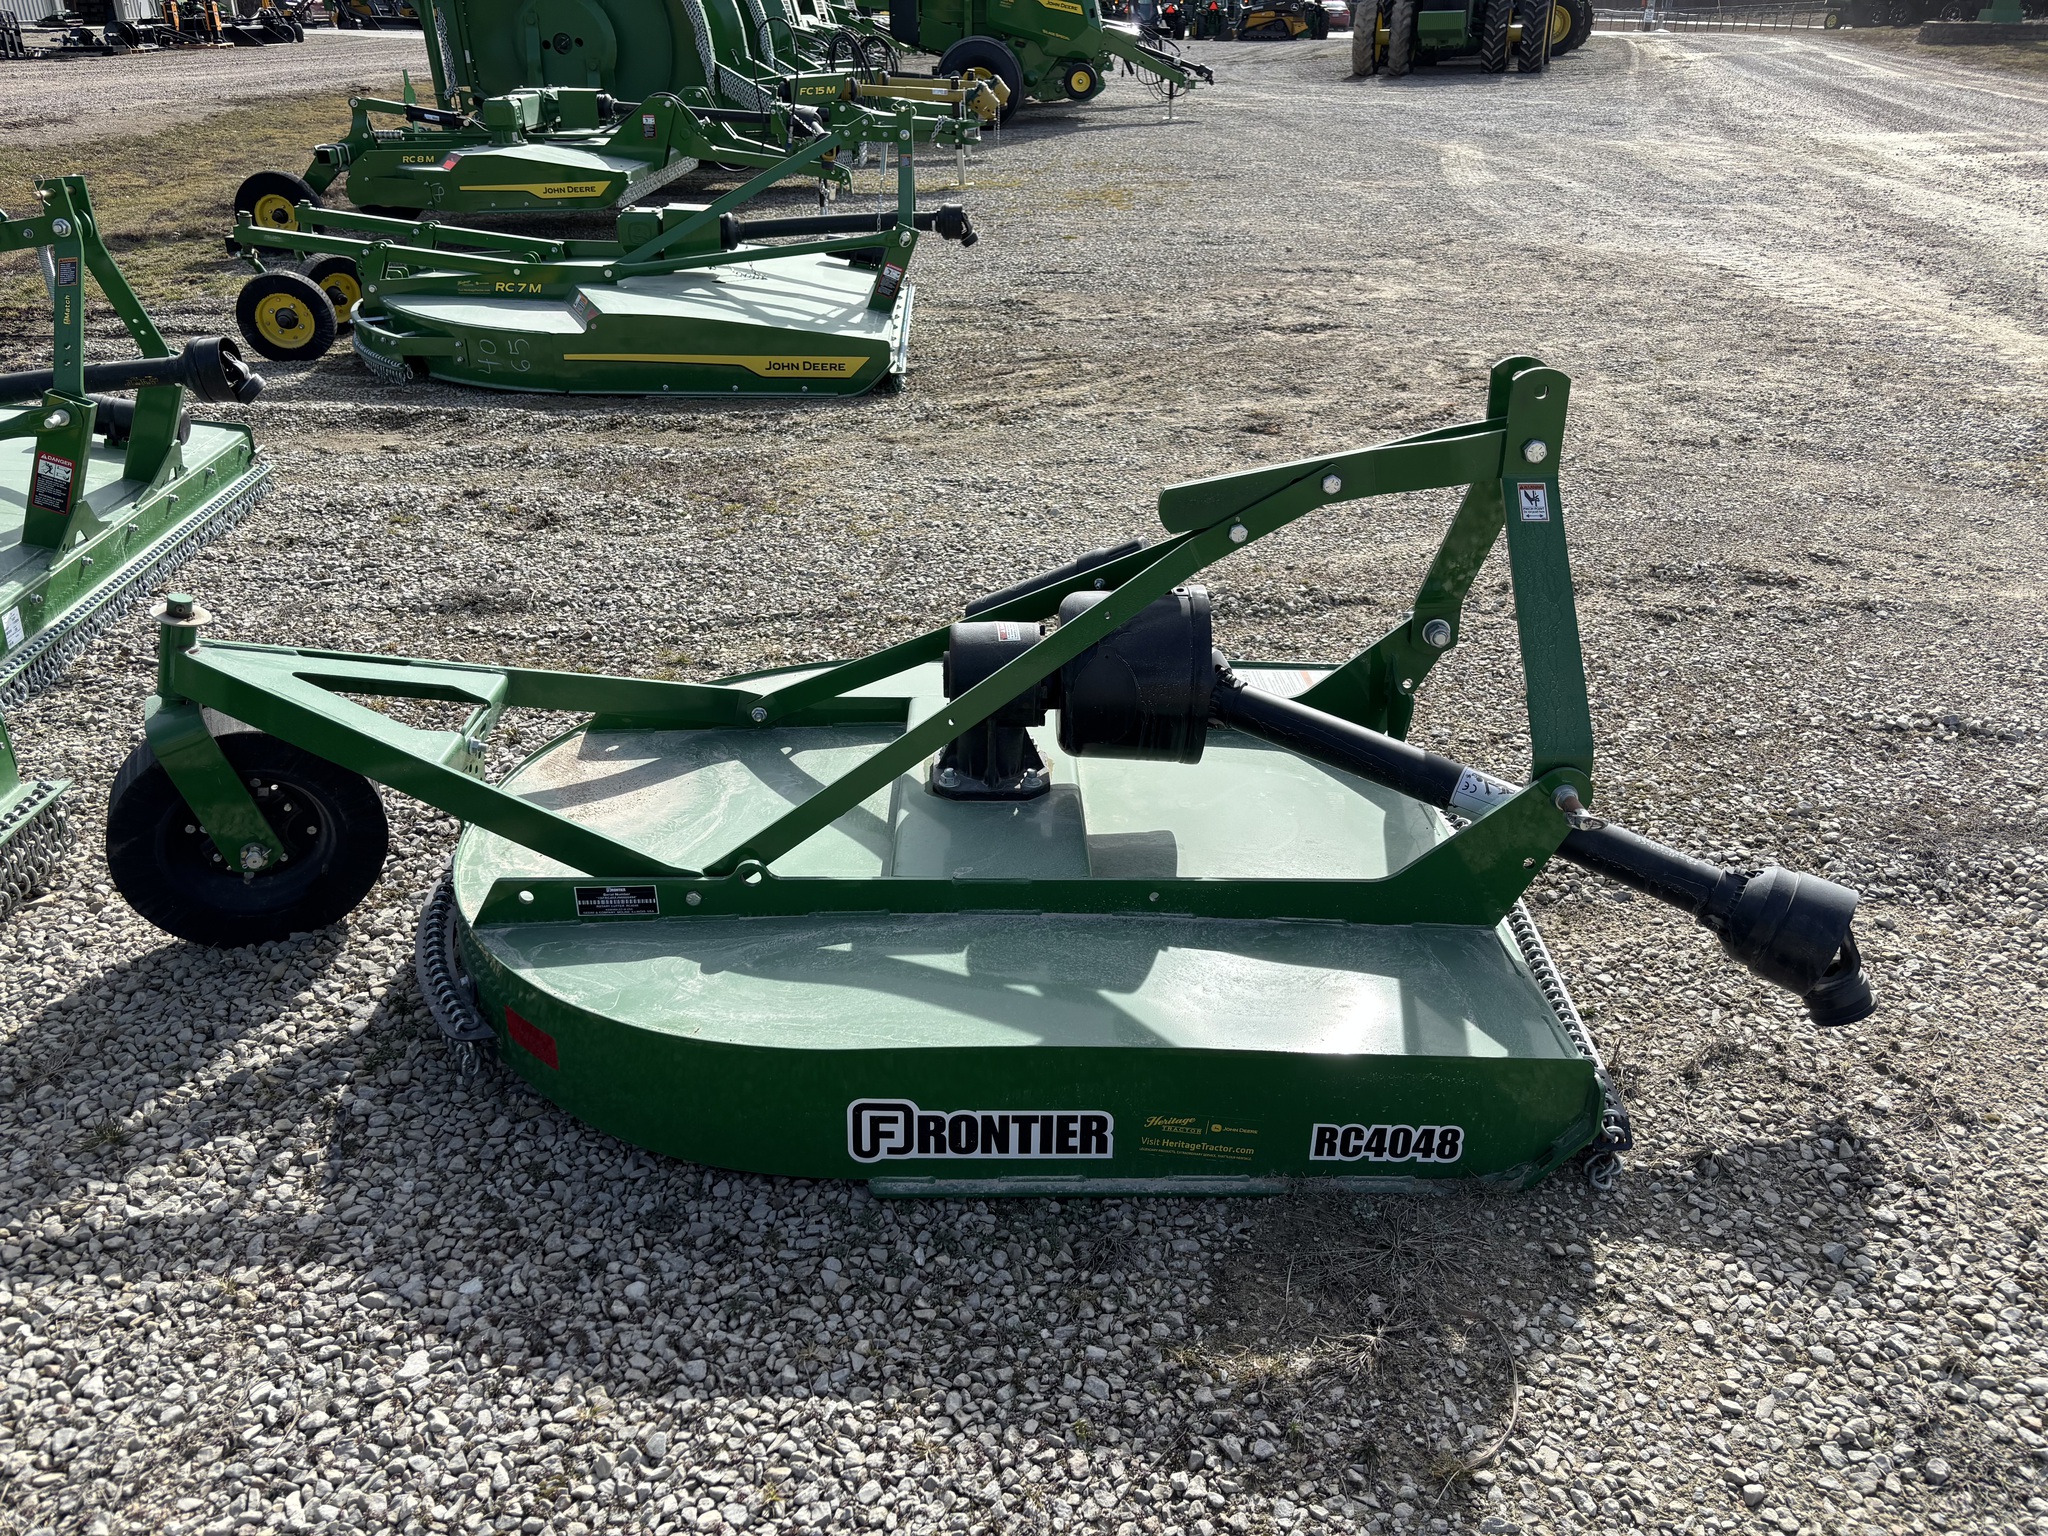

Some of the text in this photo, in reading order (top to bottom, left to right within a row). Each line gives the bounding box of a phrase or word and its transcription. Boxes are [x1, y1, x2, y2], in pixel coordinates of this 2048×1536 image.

[543, 185, 597, 195] JOHN DEERE
[764, 361, 846, 372] JOHN DEERE
[47, 455, 73, 467] DANGER
[1143, 1115, 1196, 1128] Heritage
[851, 1102, 1109, 1159] FRONTIER
[1161, 1126, 1202, 1134] TRACTOR
[1141, 1136, 1255, 1155] Visit HeritageTractor.com
[1314, 1126, 1461, 1160] RC4048
